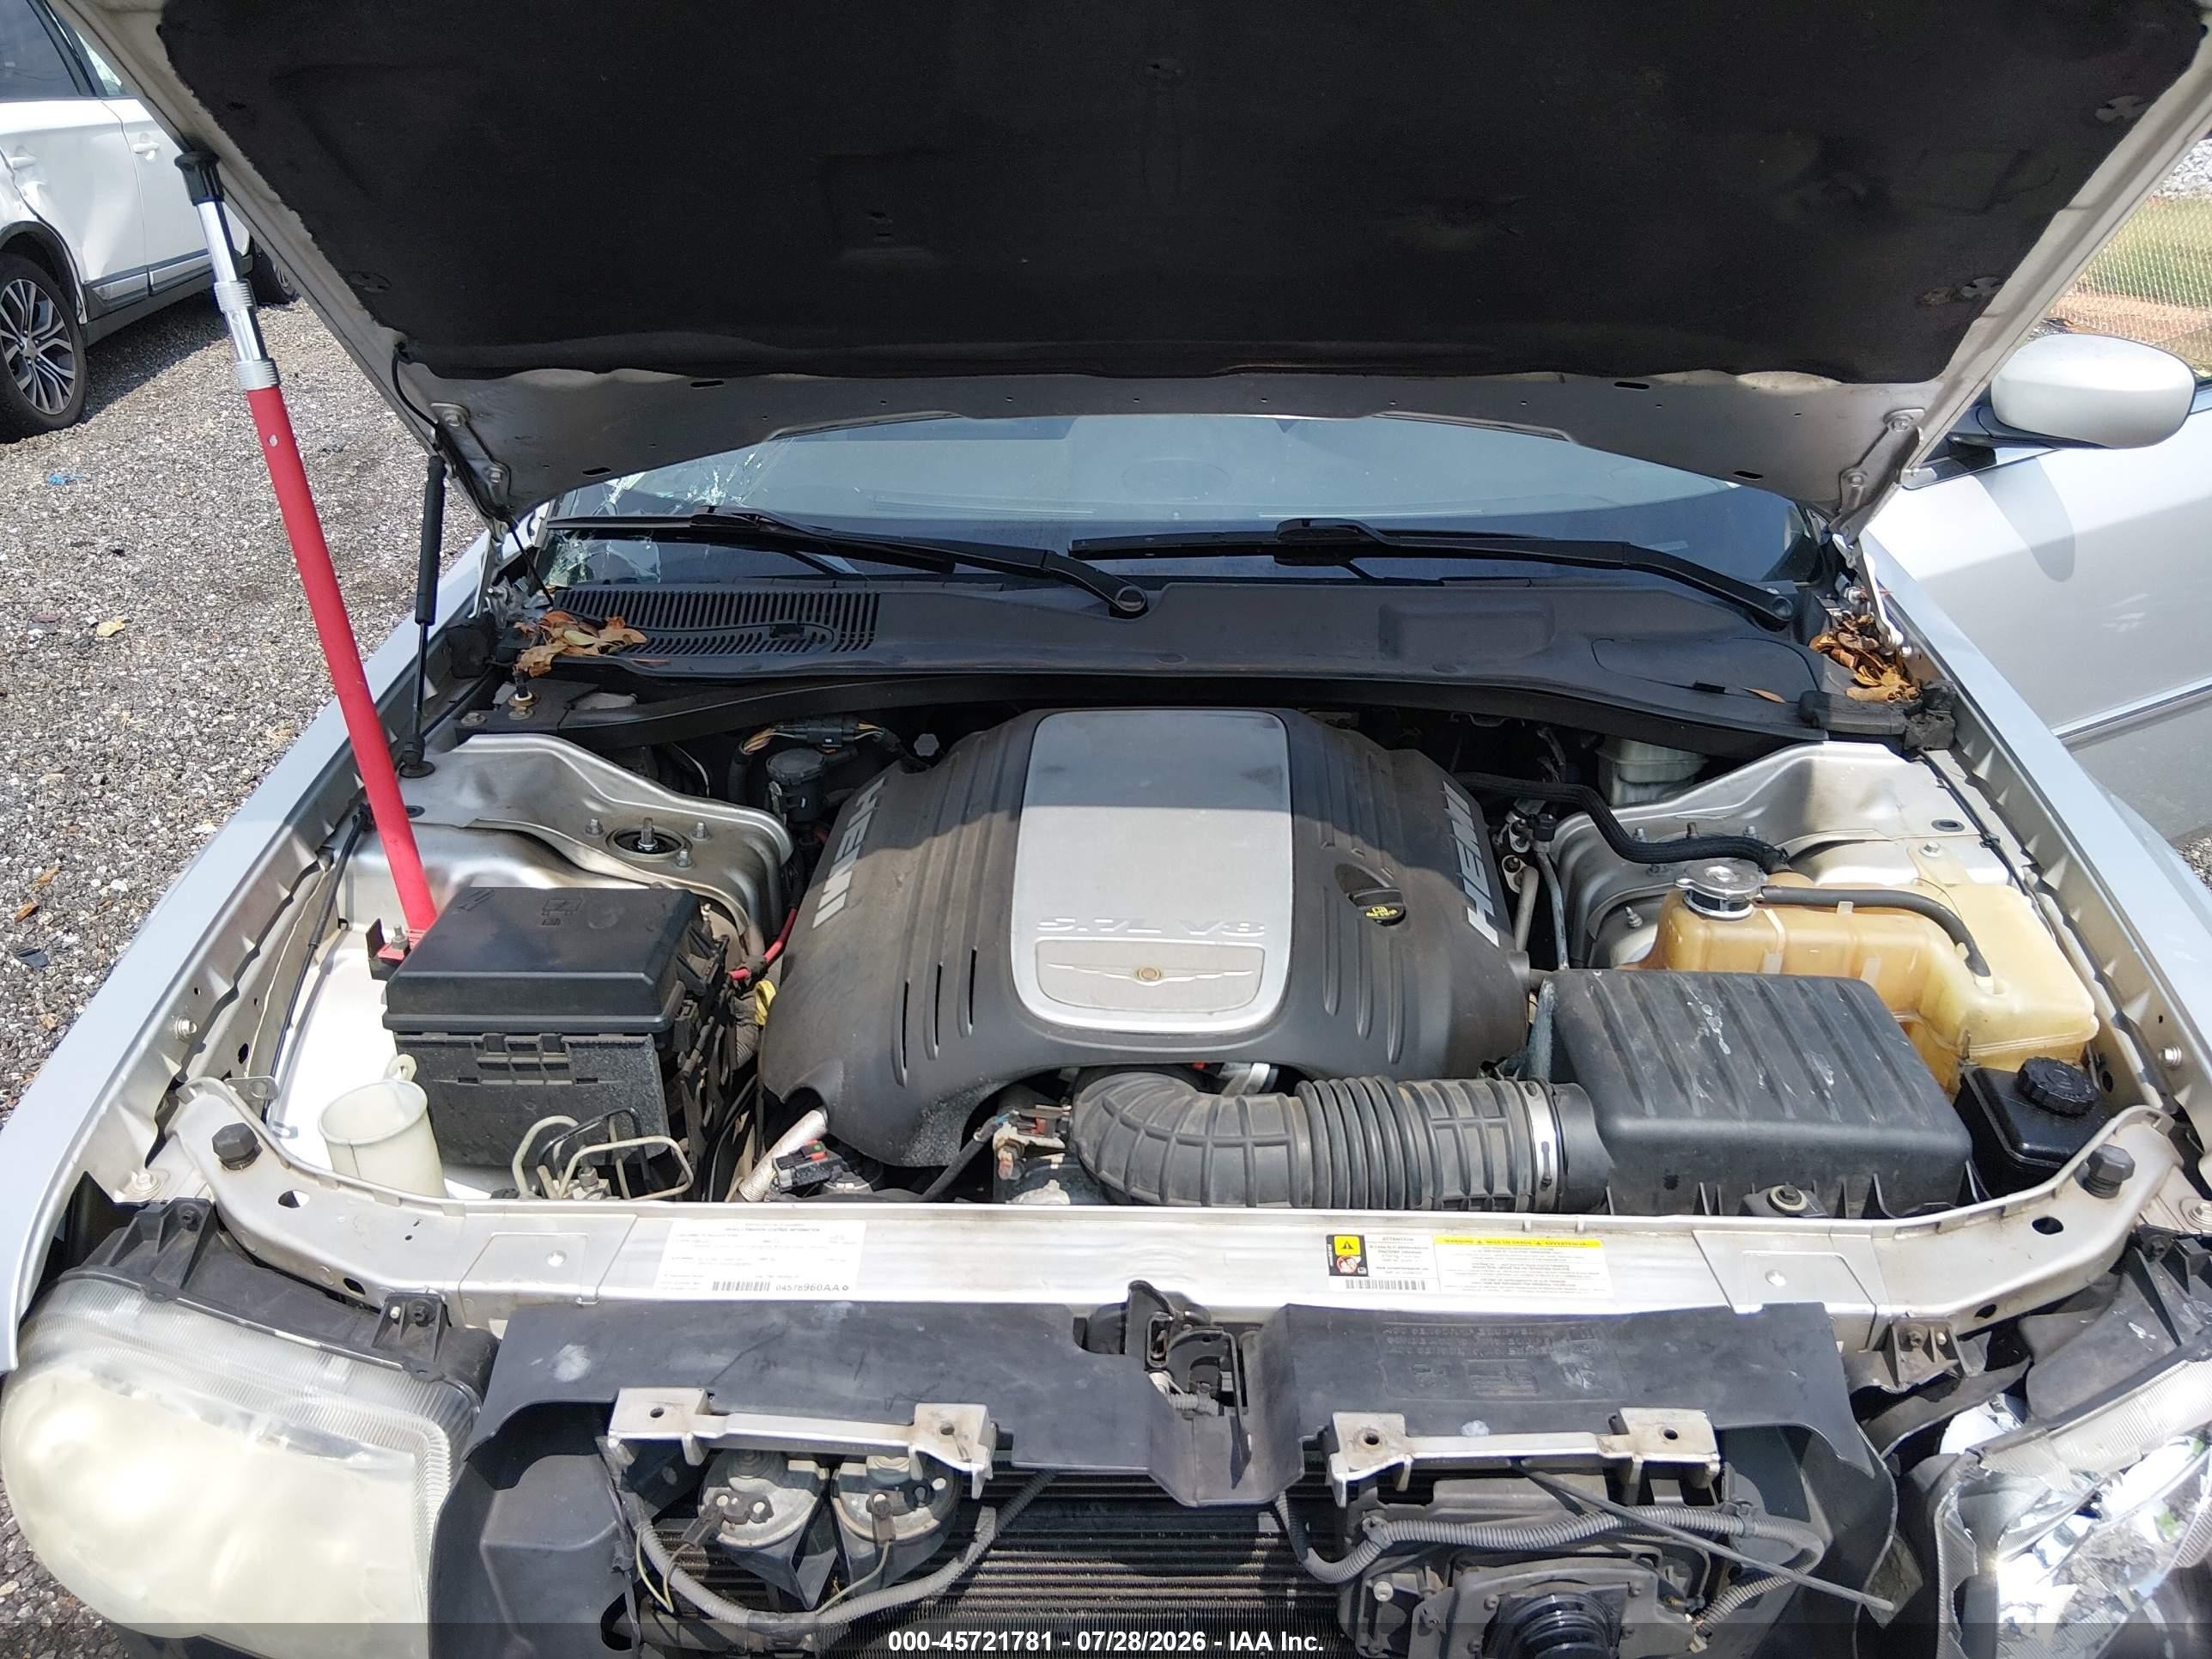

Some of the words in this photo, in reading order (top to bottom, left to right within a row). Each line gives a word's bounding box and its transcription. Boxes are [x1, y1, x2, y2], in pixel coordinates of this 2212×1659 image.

[812, 776, 886, 929] HEMI
[1180, 919, 1265, 938] V8
[1443, 780, 1500, 948] HEMI
